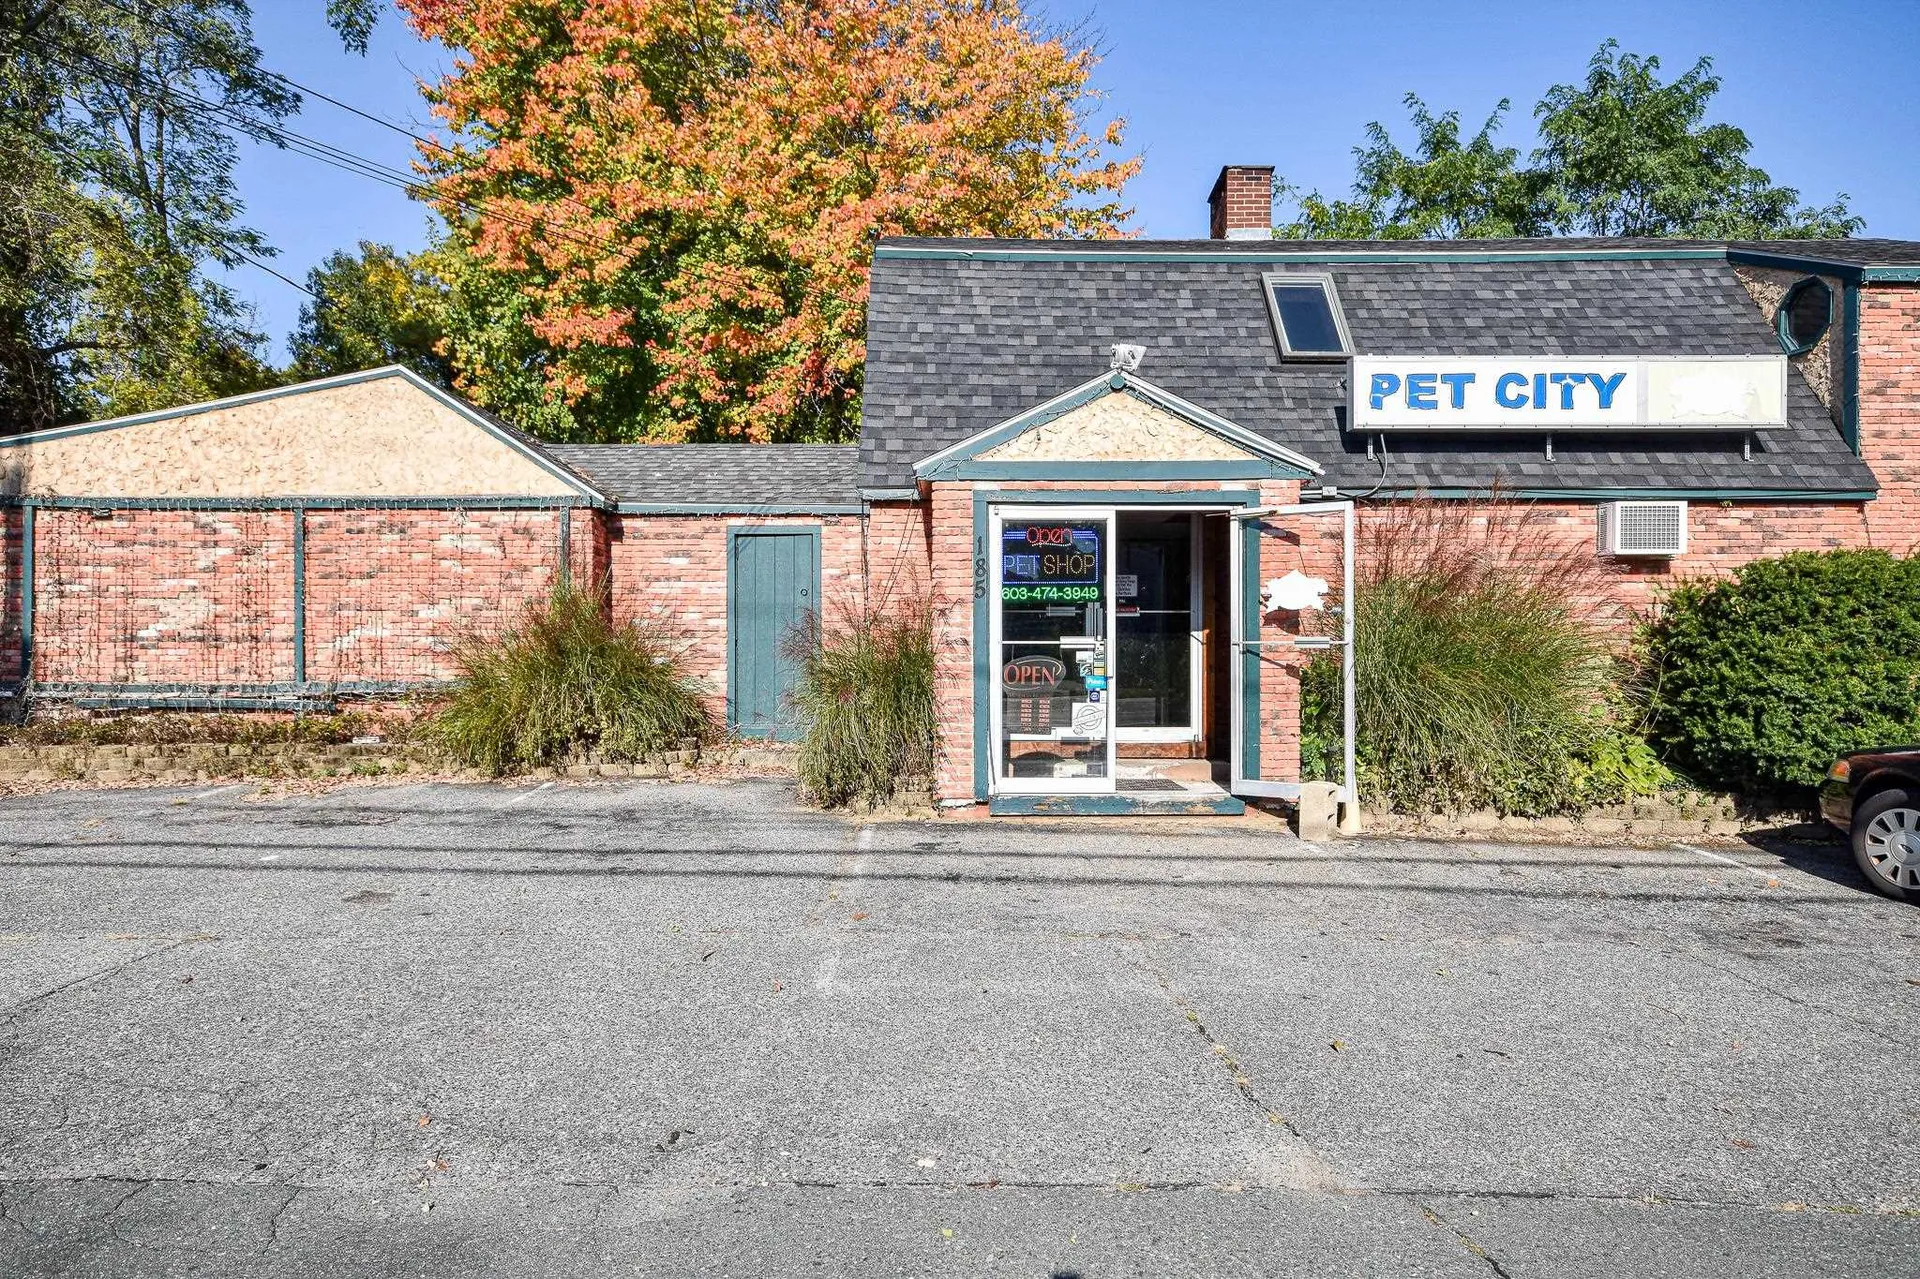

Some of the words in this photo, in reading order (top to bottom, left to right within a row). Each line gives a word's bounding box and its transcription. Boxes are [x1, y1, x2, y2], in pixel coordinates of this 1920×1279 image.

[1369, 373, 1476, 410] PET
[1495, 372, 1627, 410] CITY
[1026, 527, 1072, 546] Open
[975, 535, 986, 599] 185
[1003, 554, 1040, 575] PET
[1043, 554, 1095, 575] SHOP
[1001, 587, 1098, 600] 603-474-3949
[1003, 664, 1056, 686] OPEN
